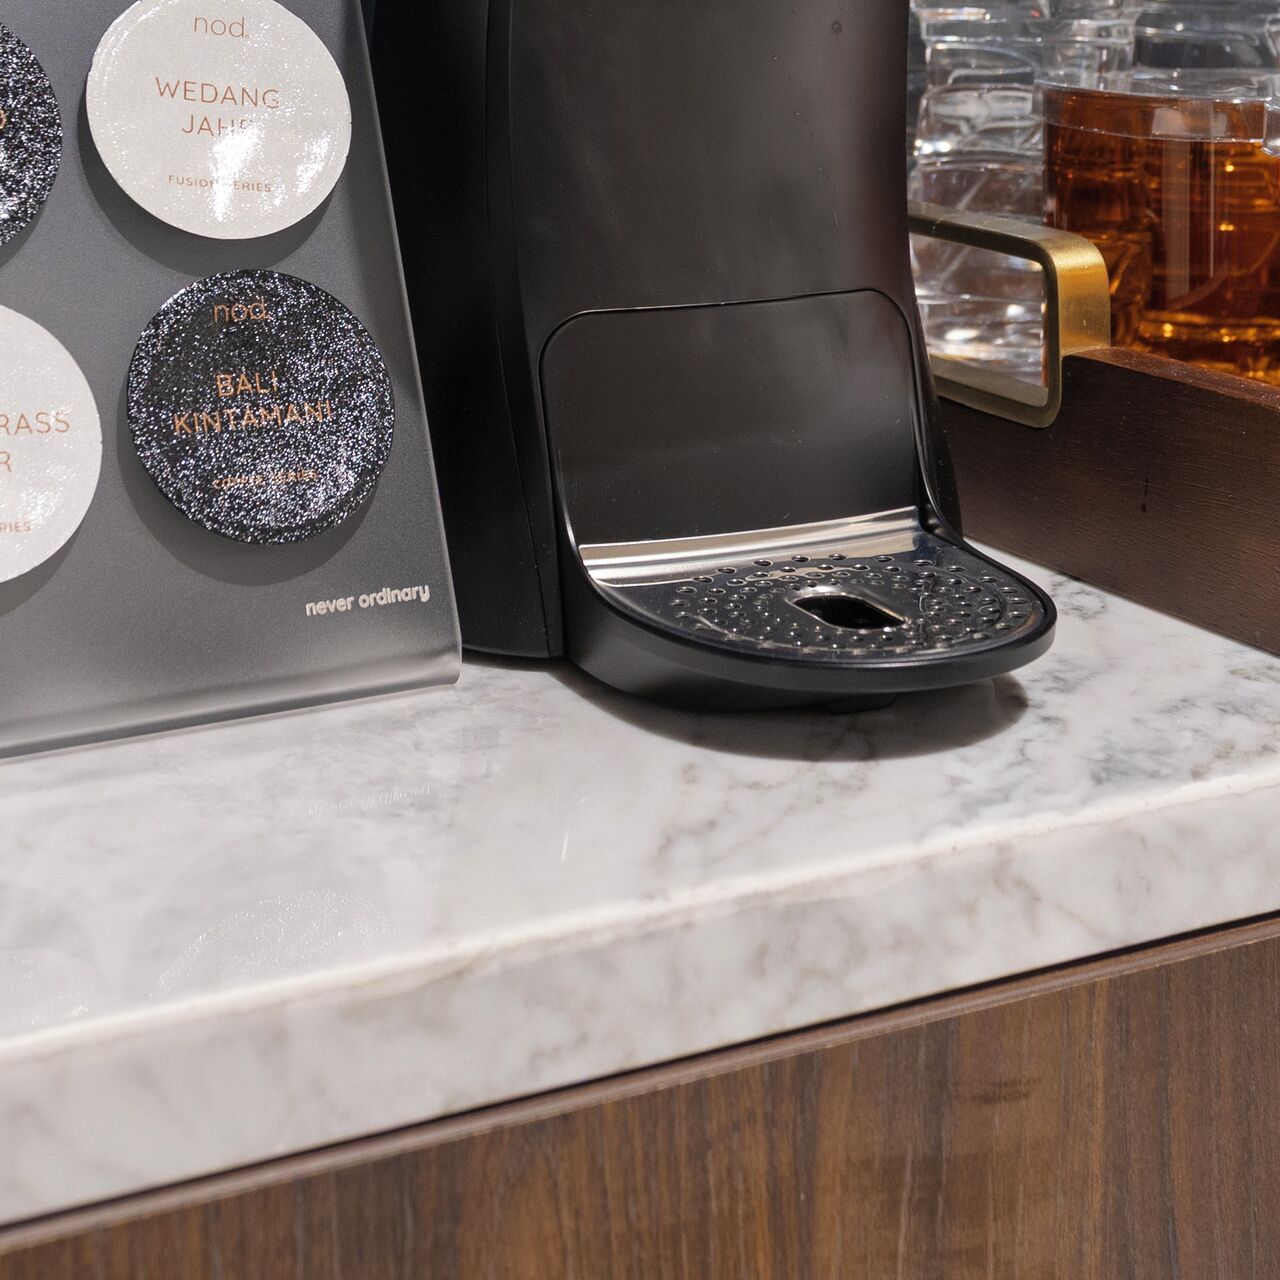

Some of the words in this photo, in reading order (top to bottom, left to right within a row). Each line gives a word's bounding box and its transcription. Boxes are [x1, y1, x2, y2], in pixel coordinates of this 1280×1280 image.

[193, 16, 250, 39] nod.
[155, 77, 279, 110] WEDANG
[226, 180, 272, 193] ERIES
[215, 371, 279, 398] BALI
[173, 400, 334, 434] KINTAMANI
[305, 596, 355, 616] never
[358, 585, 430, 608] ordinary
